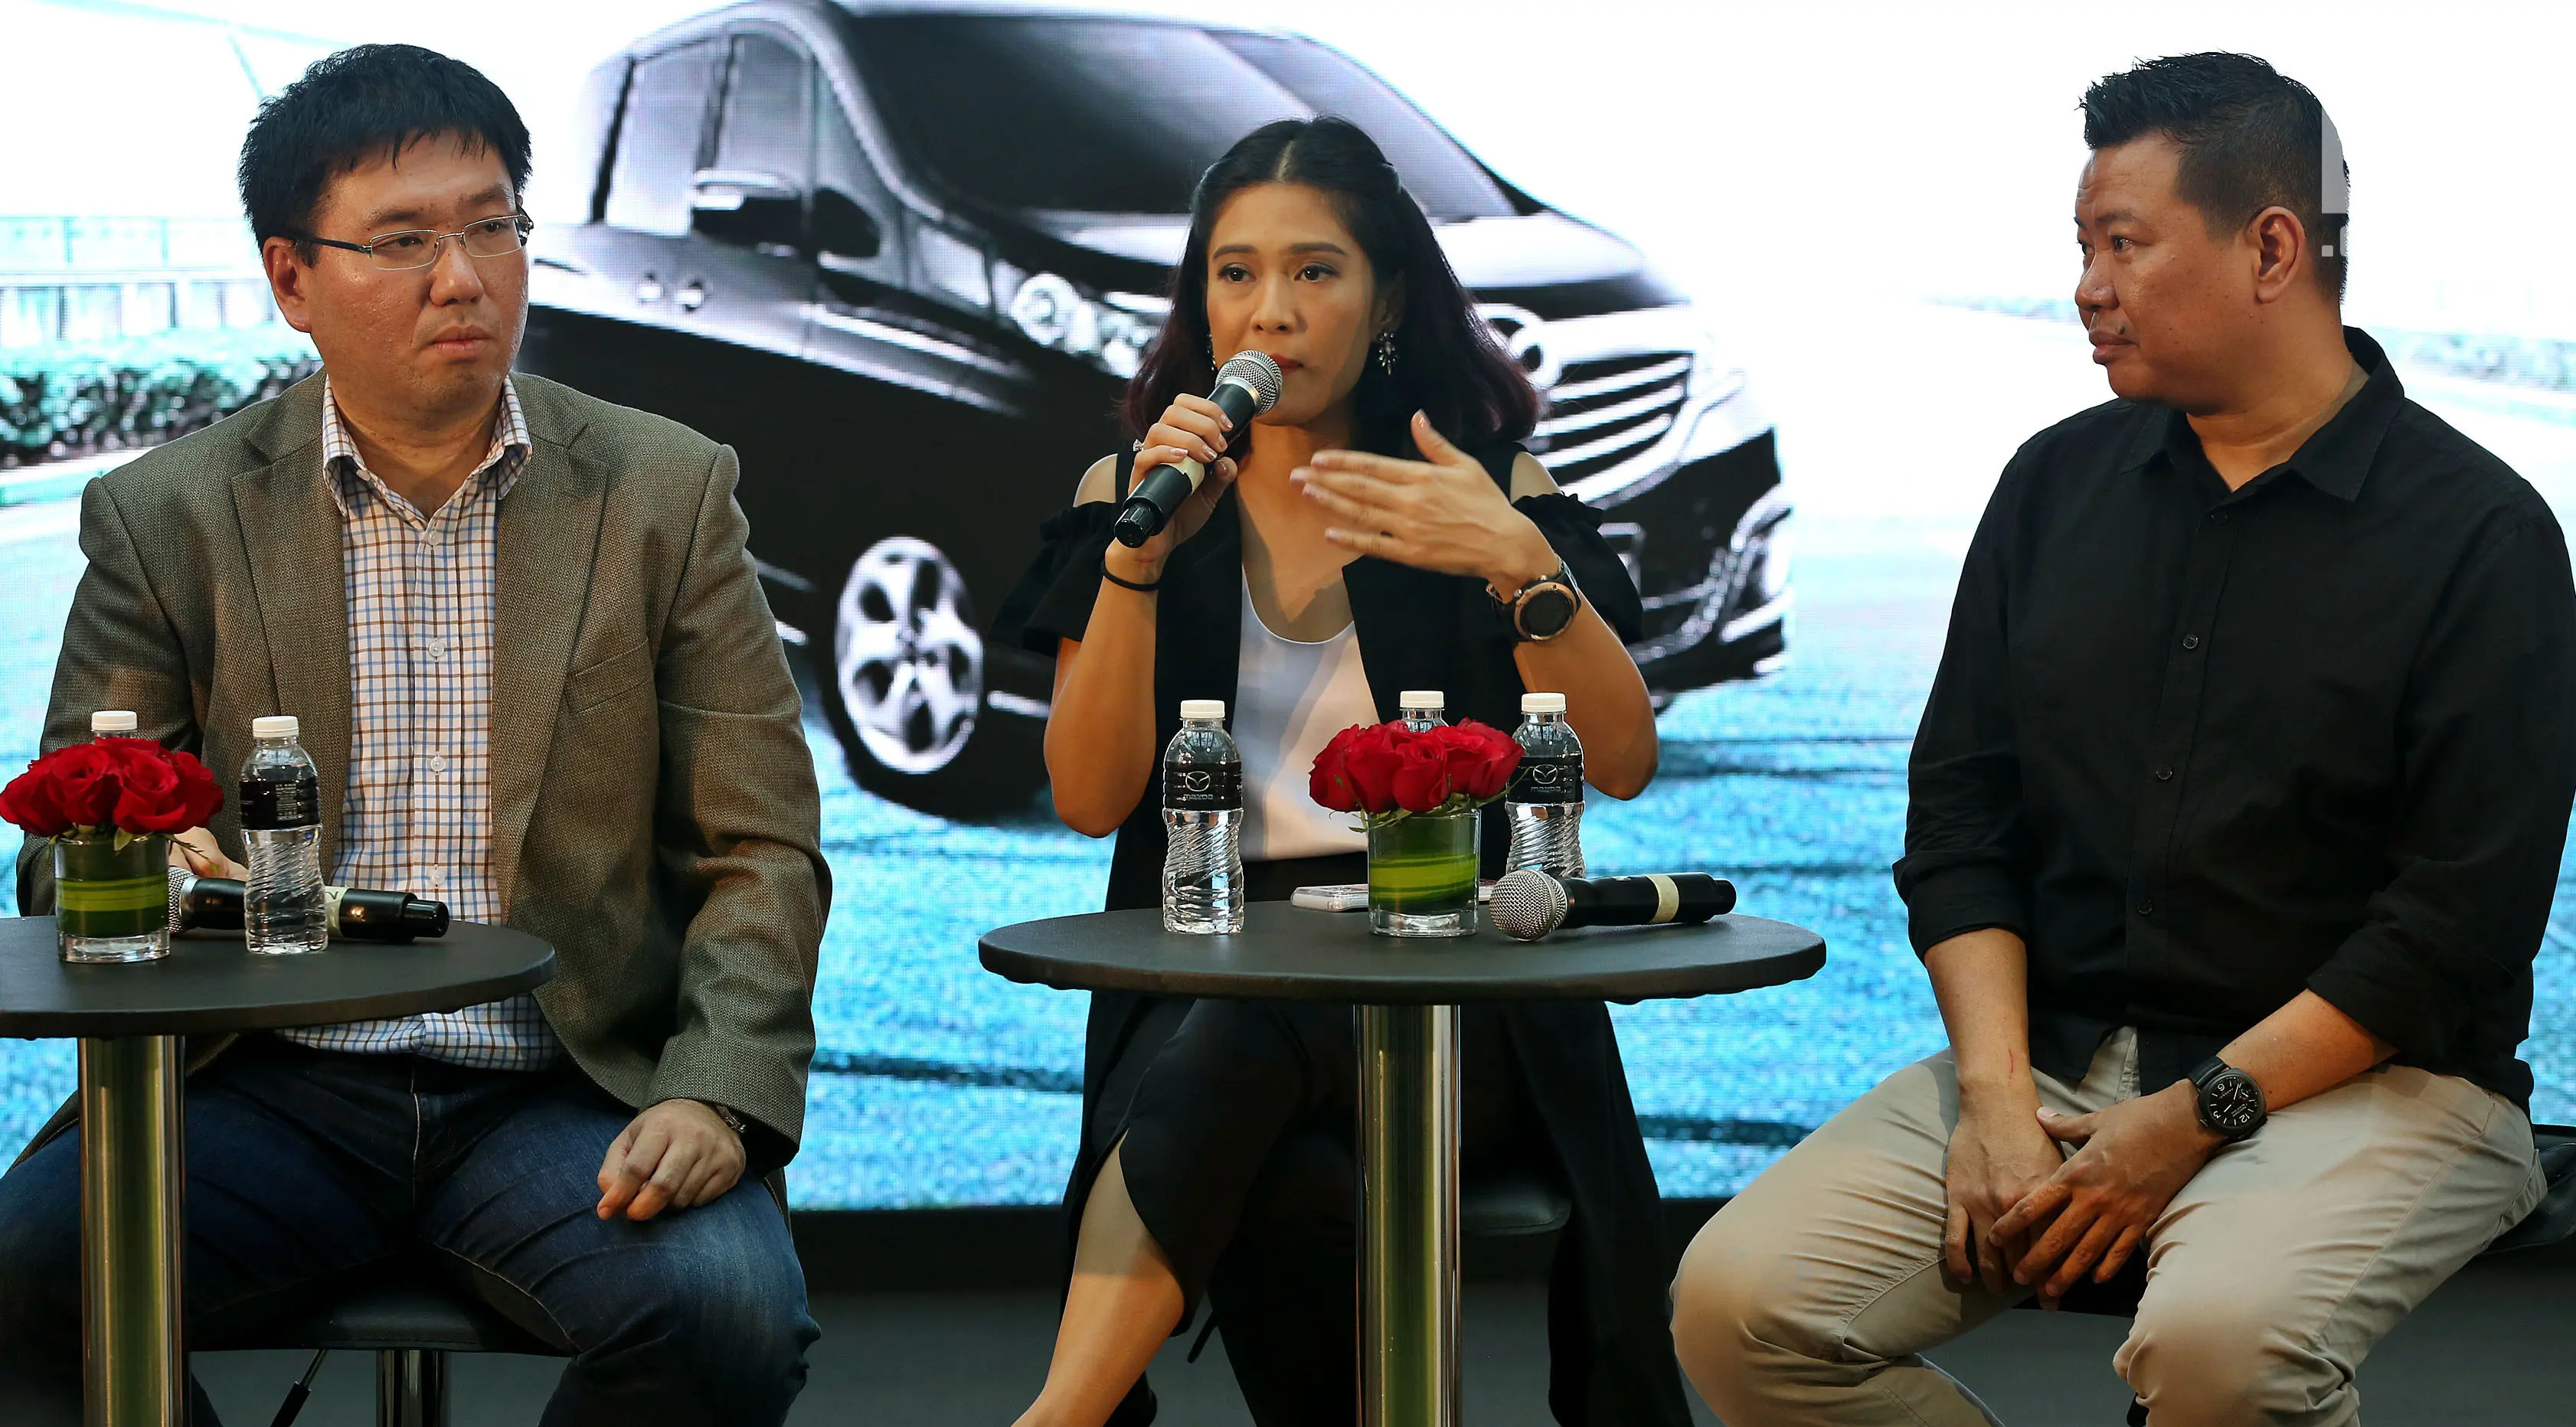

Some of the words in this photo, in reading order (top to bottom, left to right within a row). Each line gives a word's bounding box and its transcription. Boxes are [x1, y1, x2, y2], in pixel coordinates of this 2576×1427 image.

[2217, 1083, 2225, 1092] 6
[2213, 1110, 2221, 1118] 3
[2239, 1113, 2250, 1123] 12
